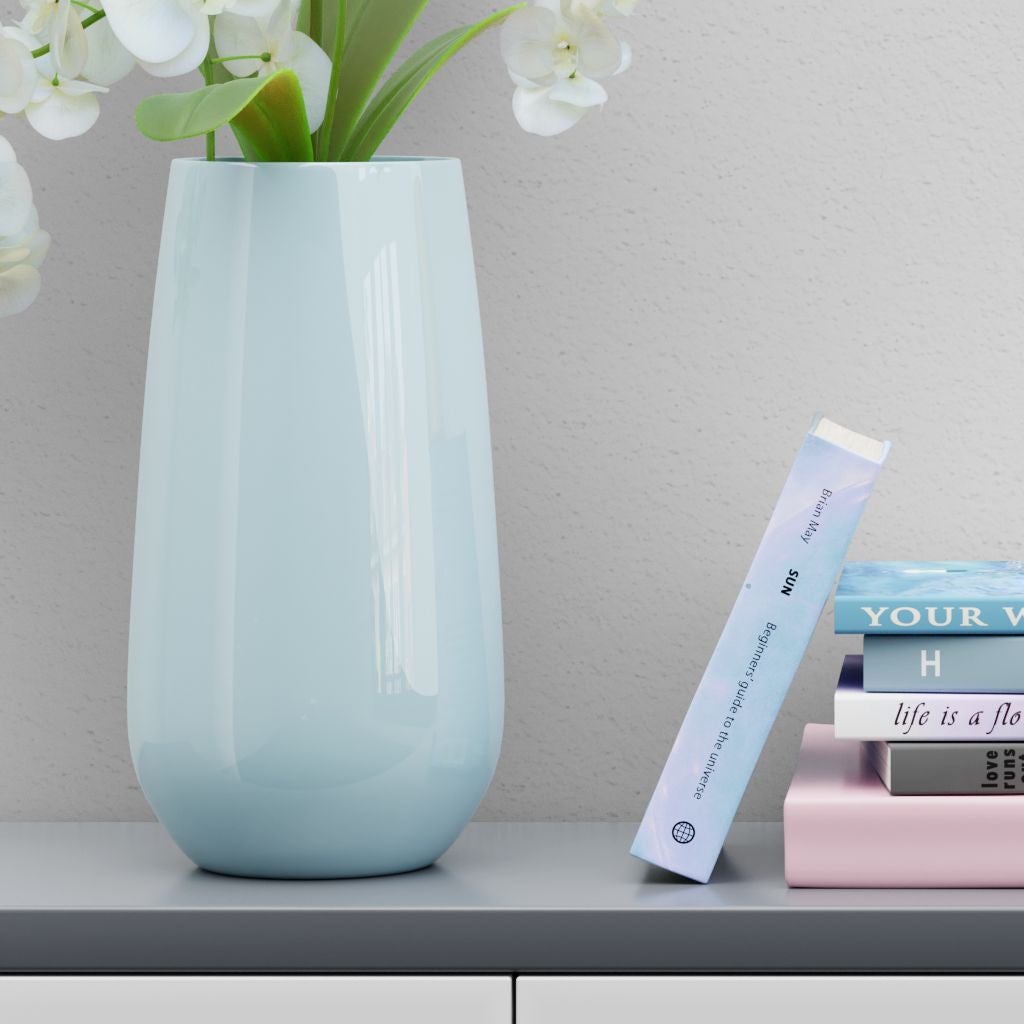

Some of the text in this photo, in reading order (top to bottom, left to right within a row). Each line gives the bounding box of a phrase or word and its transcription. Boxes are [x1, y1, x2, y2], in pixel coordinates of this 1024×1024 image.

[800, 488, 833, 545] Brian May
[780, 568, 800, 597] SUN
[860, 606, 989, 627] YOUR
[693, 621, 778, 801] Beginners' guide to the universe
[893, 701, 931, 735] life
[940, 705, 960, 727] is
[968, 710, 985, 726] a
[980, 750, 999, 789] love
[1003, 748, 1016, 790] runs
